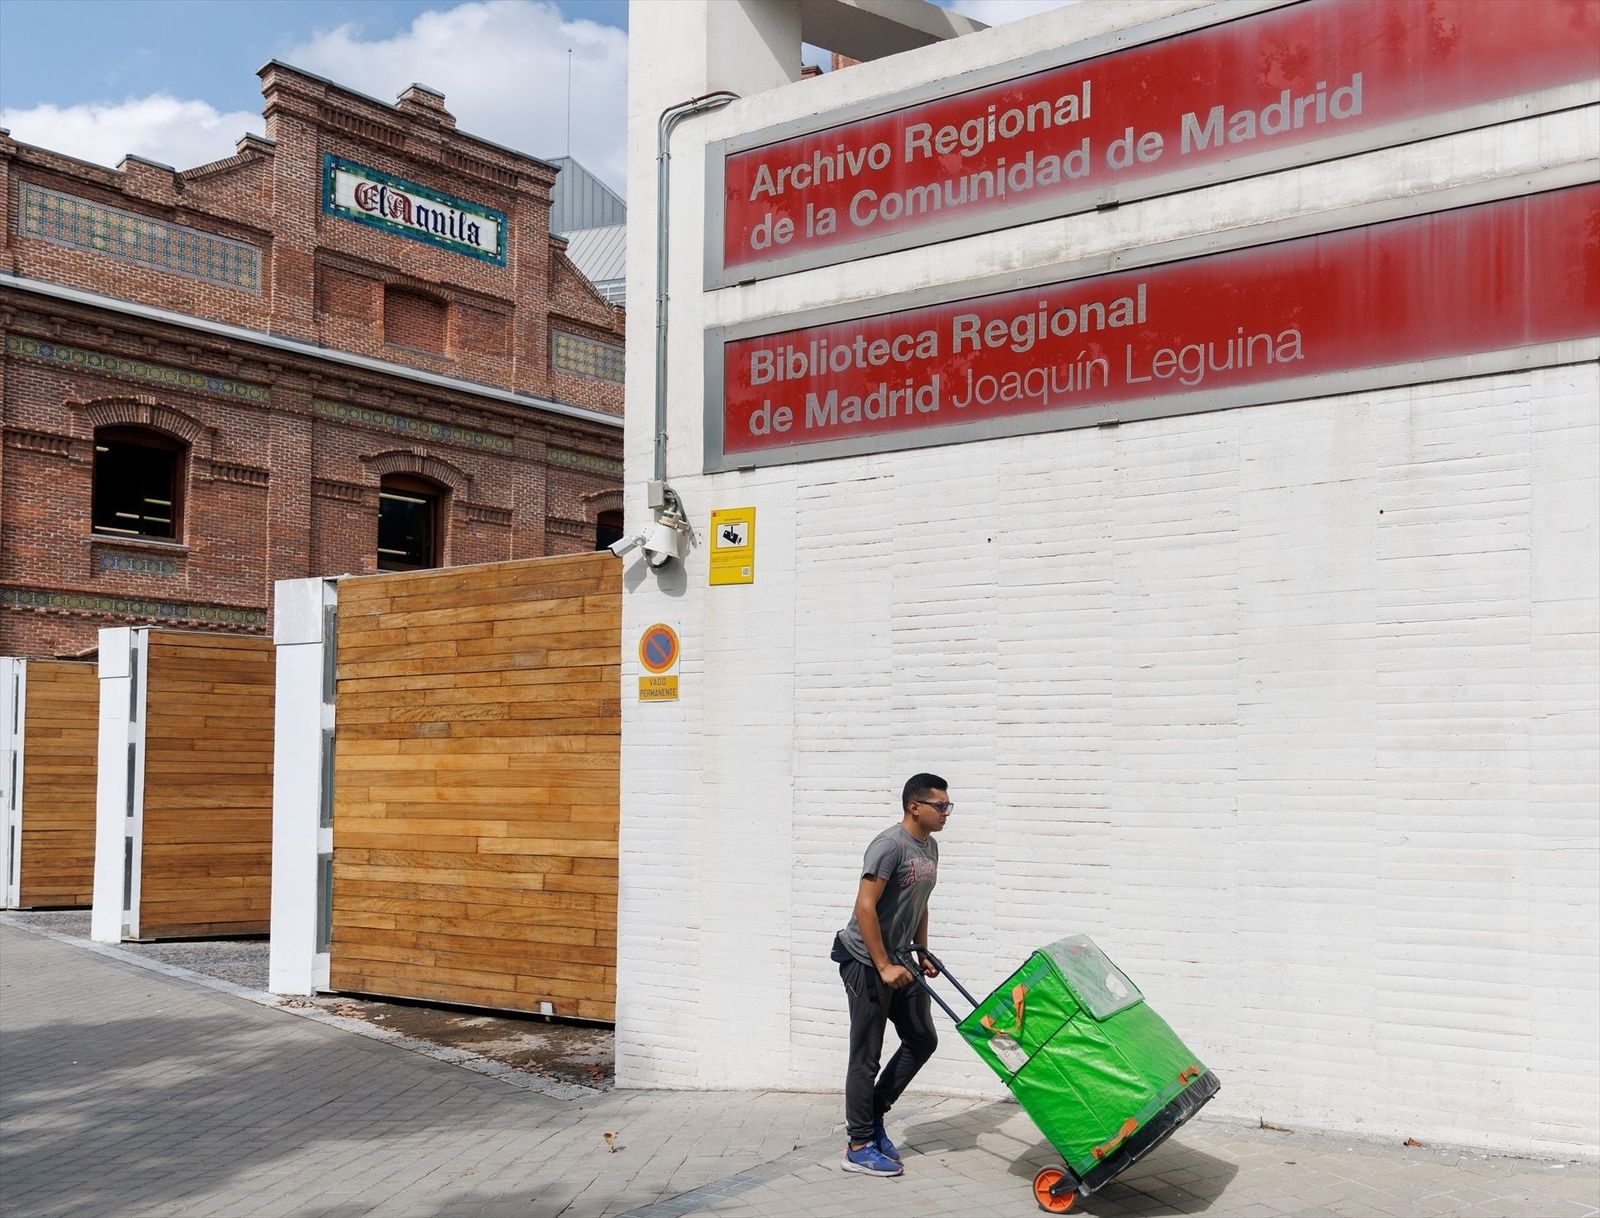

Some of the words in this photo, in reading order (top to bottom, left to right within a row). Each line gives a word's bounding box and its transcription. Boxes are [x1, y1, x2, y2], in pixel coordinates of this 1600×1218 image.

[749, 142, 892, 201] Archivo
[904, 80, 1093, 163] Regional
[749, 211, 794, 252] de
[805, 202, 837, 239] la
[848, 137, 1091, 228] Comunidad
[1106, 127, 1164, 171] de
[1180, 73, 1364, 154] Madrid
[354, 182, 389, 218] El
[387, 189, 482, 247] Aquila
[748, 397, 793, 437] de
[804, 374, 941, 429] Madrid
[951, 347, 1110, 409] Joaquín
[1125, 326, 1305, 387] Leguina
[751, 328, 938, 386] Biblioteca
[952, 283, 1148, 354] Regional
[640, 688, 677, 697] PERMANENTE
[649, 677, 667, 686] VADO
